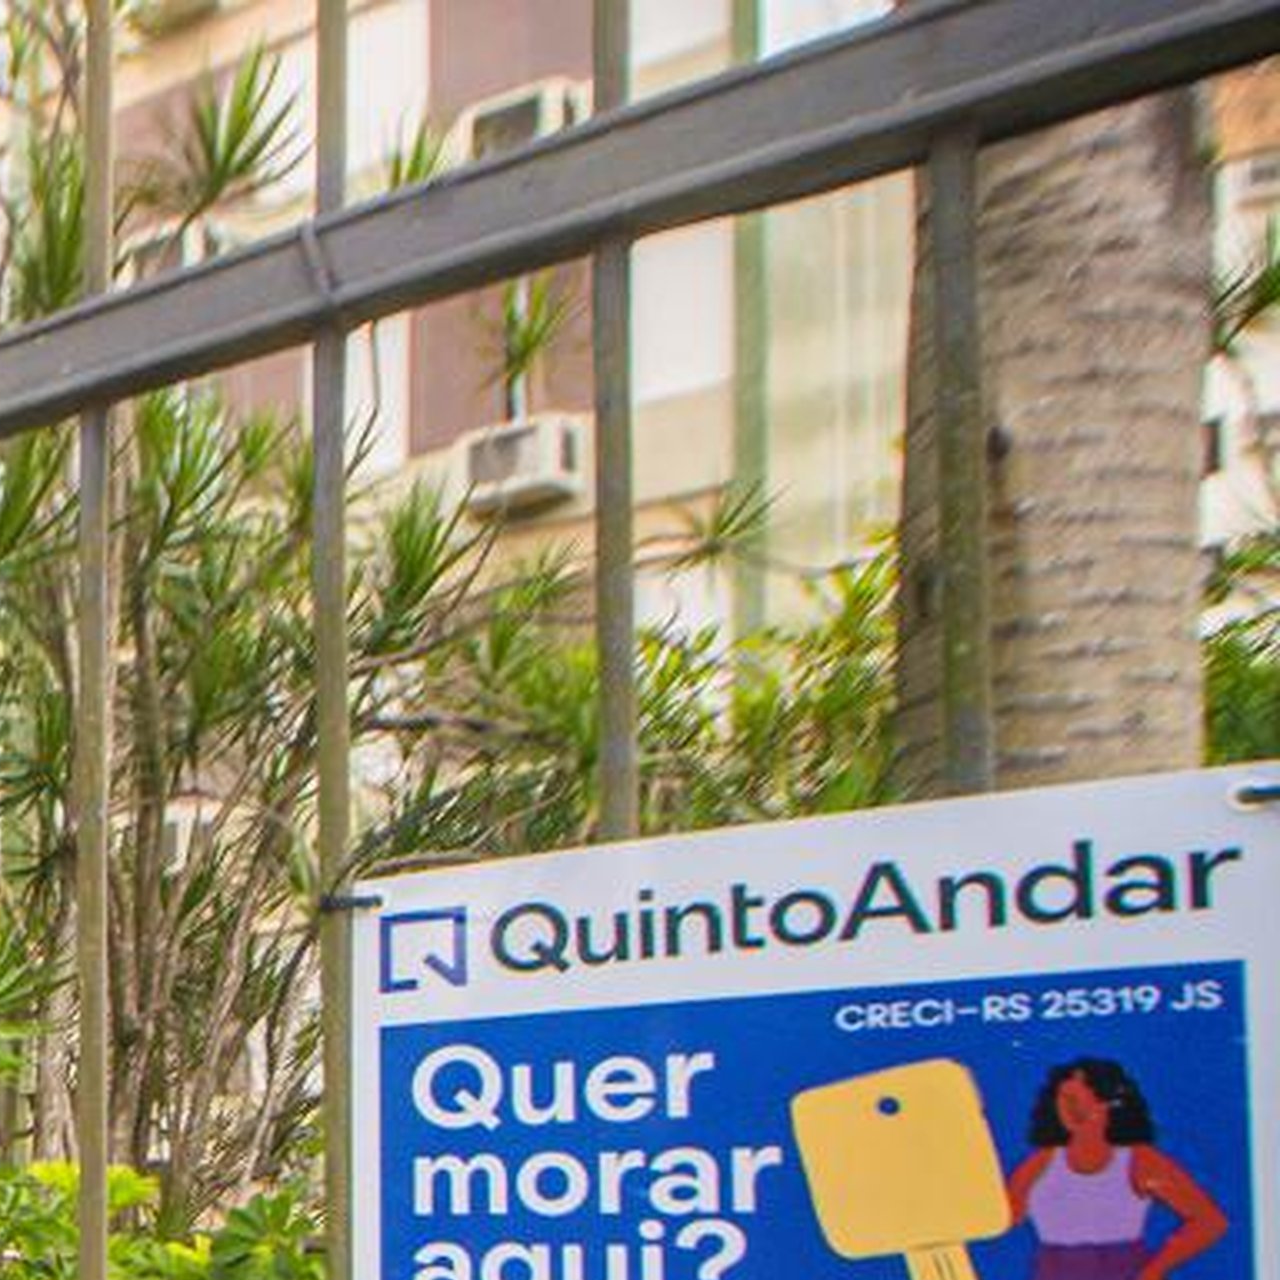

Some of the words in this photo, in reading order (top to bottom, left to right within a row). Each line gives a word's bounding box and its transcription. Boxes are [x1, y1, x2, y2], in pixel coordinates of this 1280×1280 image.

[491, 839, 1241, 974] QuintoAndar
[836, 993, 1030, 1032] CRECI-RS
[1041, 985, 1161, 1020] 25319
[1171, 980, 1223, 1011] JS
[411, 1045, 715, 1132] Quer
[413, 1144, 781, 1216] morar
